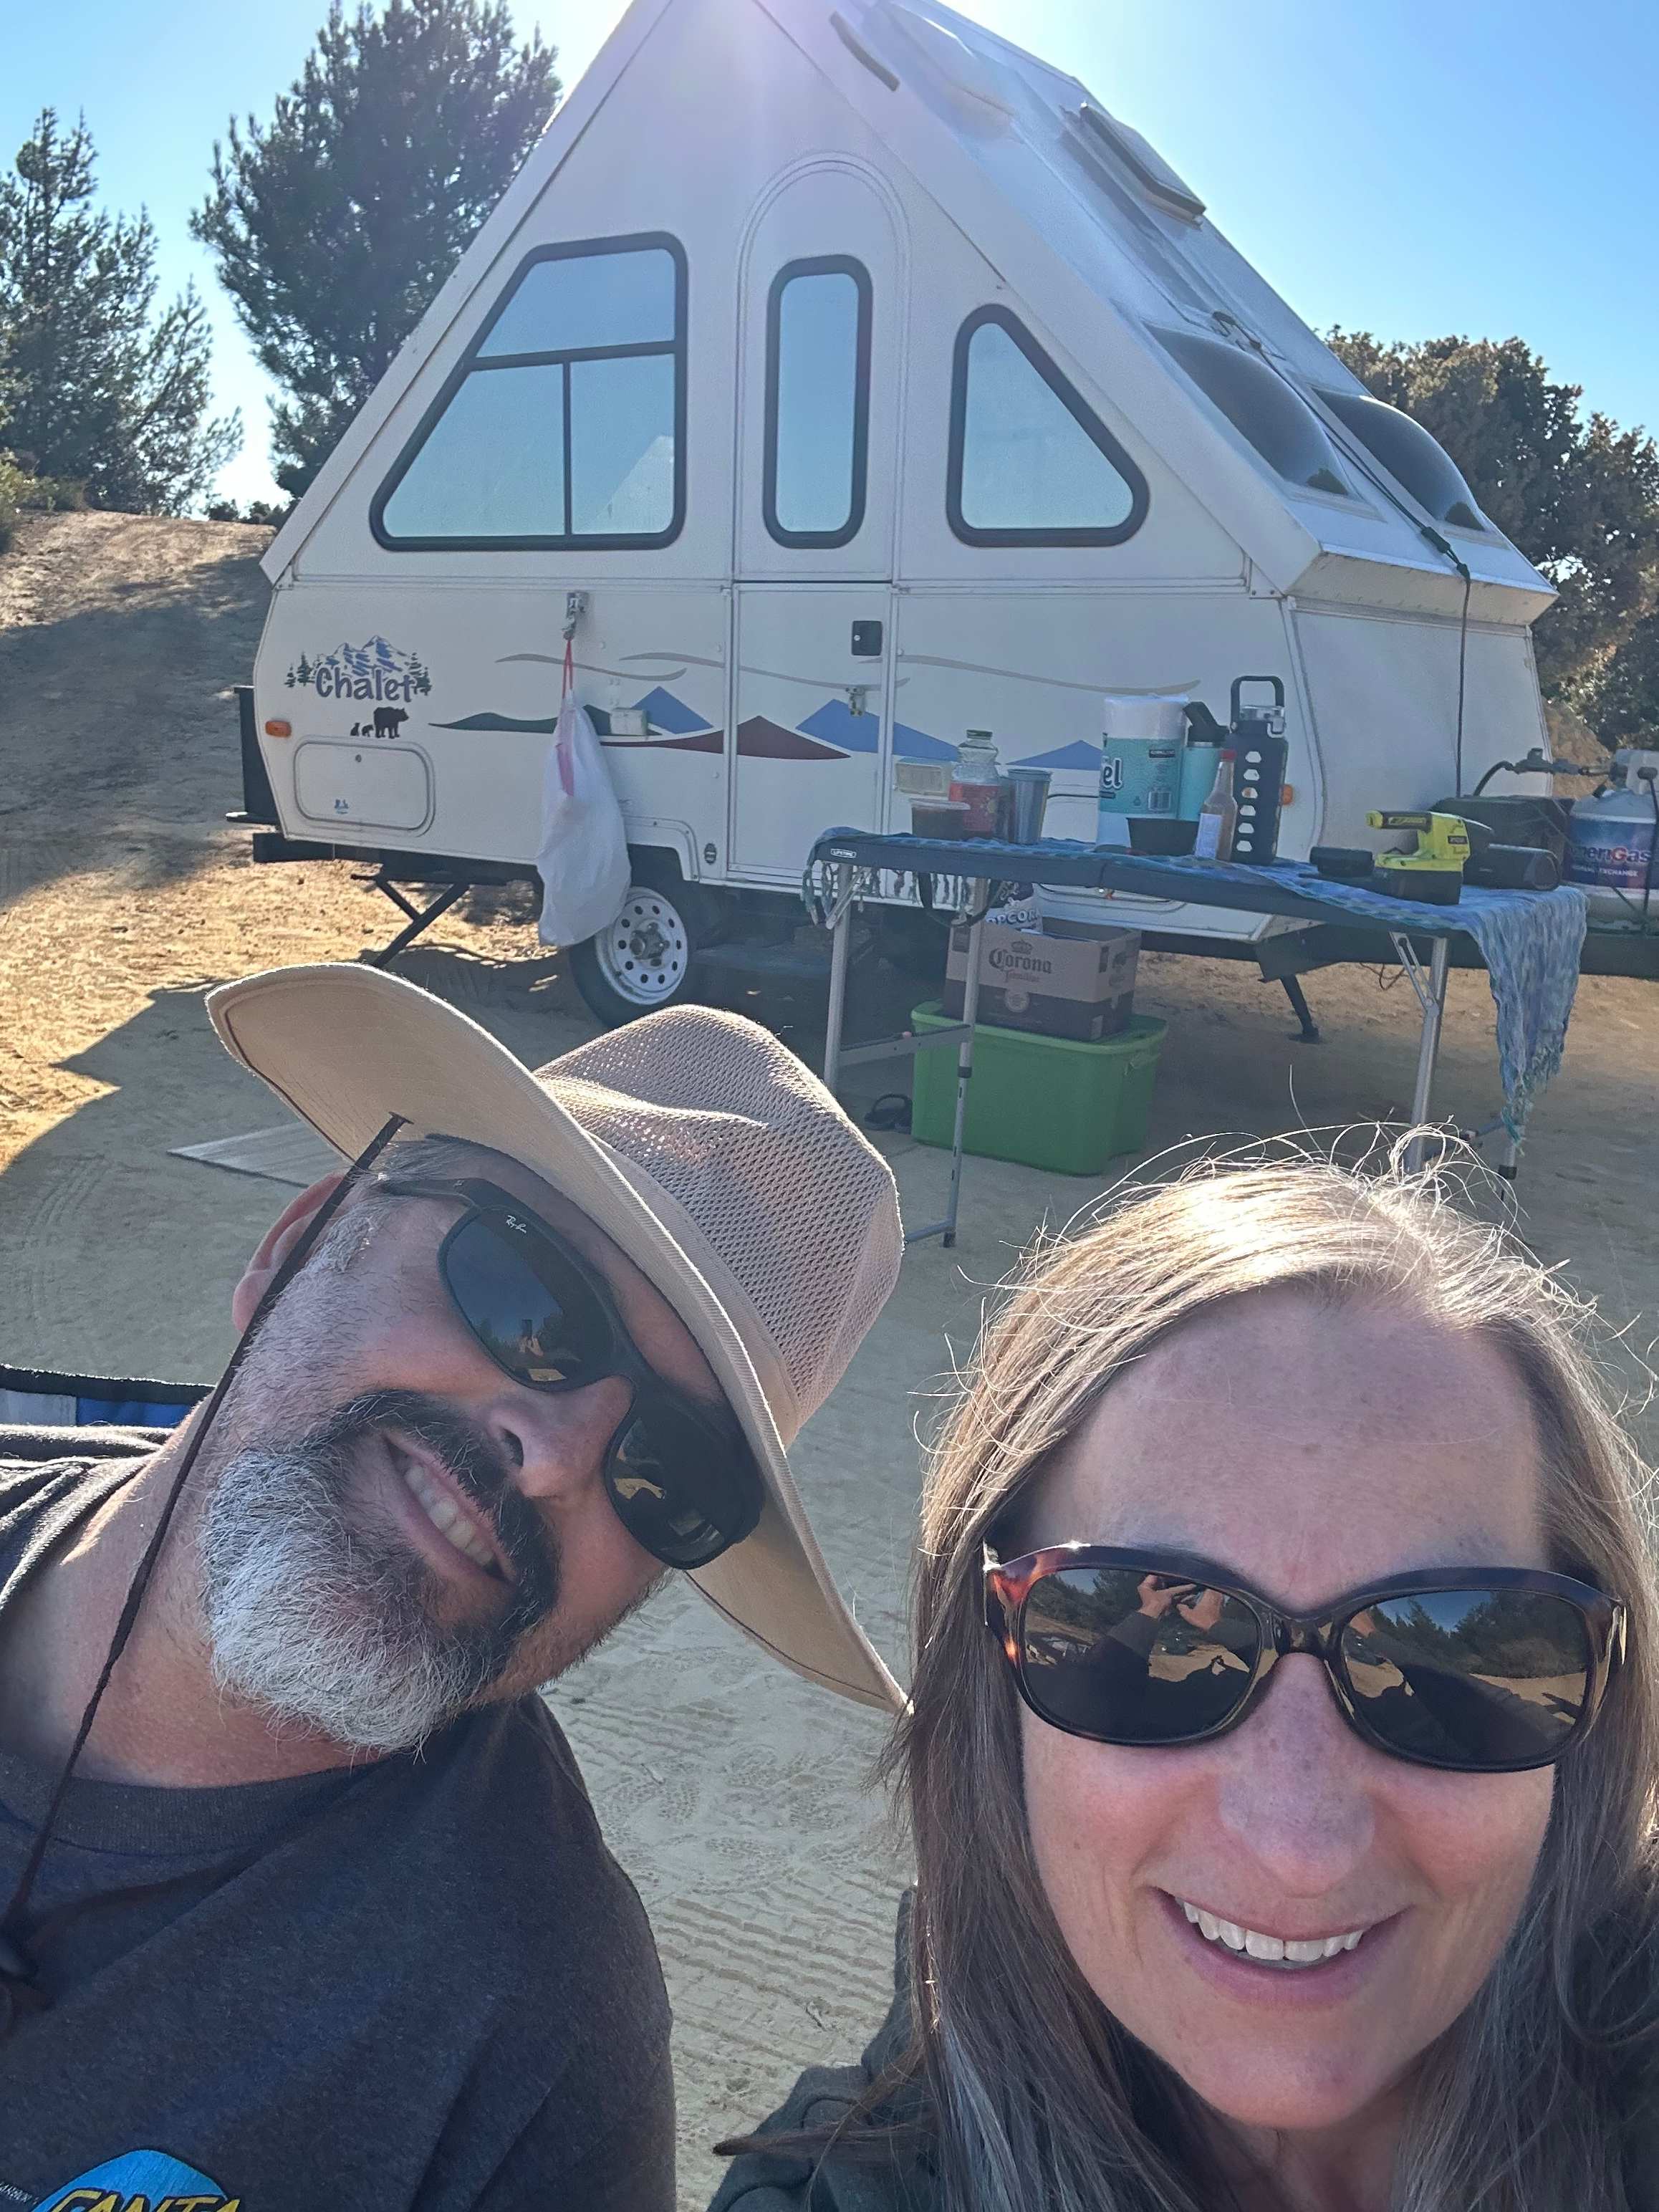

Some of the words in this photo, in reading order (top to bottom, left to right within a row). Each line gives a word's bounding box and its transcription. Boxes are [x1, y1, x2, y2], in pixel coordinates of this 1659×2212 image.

[316, 666, 412, 703] Chalet
[1102, 757, 1123, 789] el
[989, 948, 1052, 974] Corona
